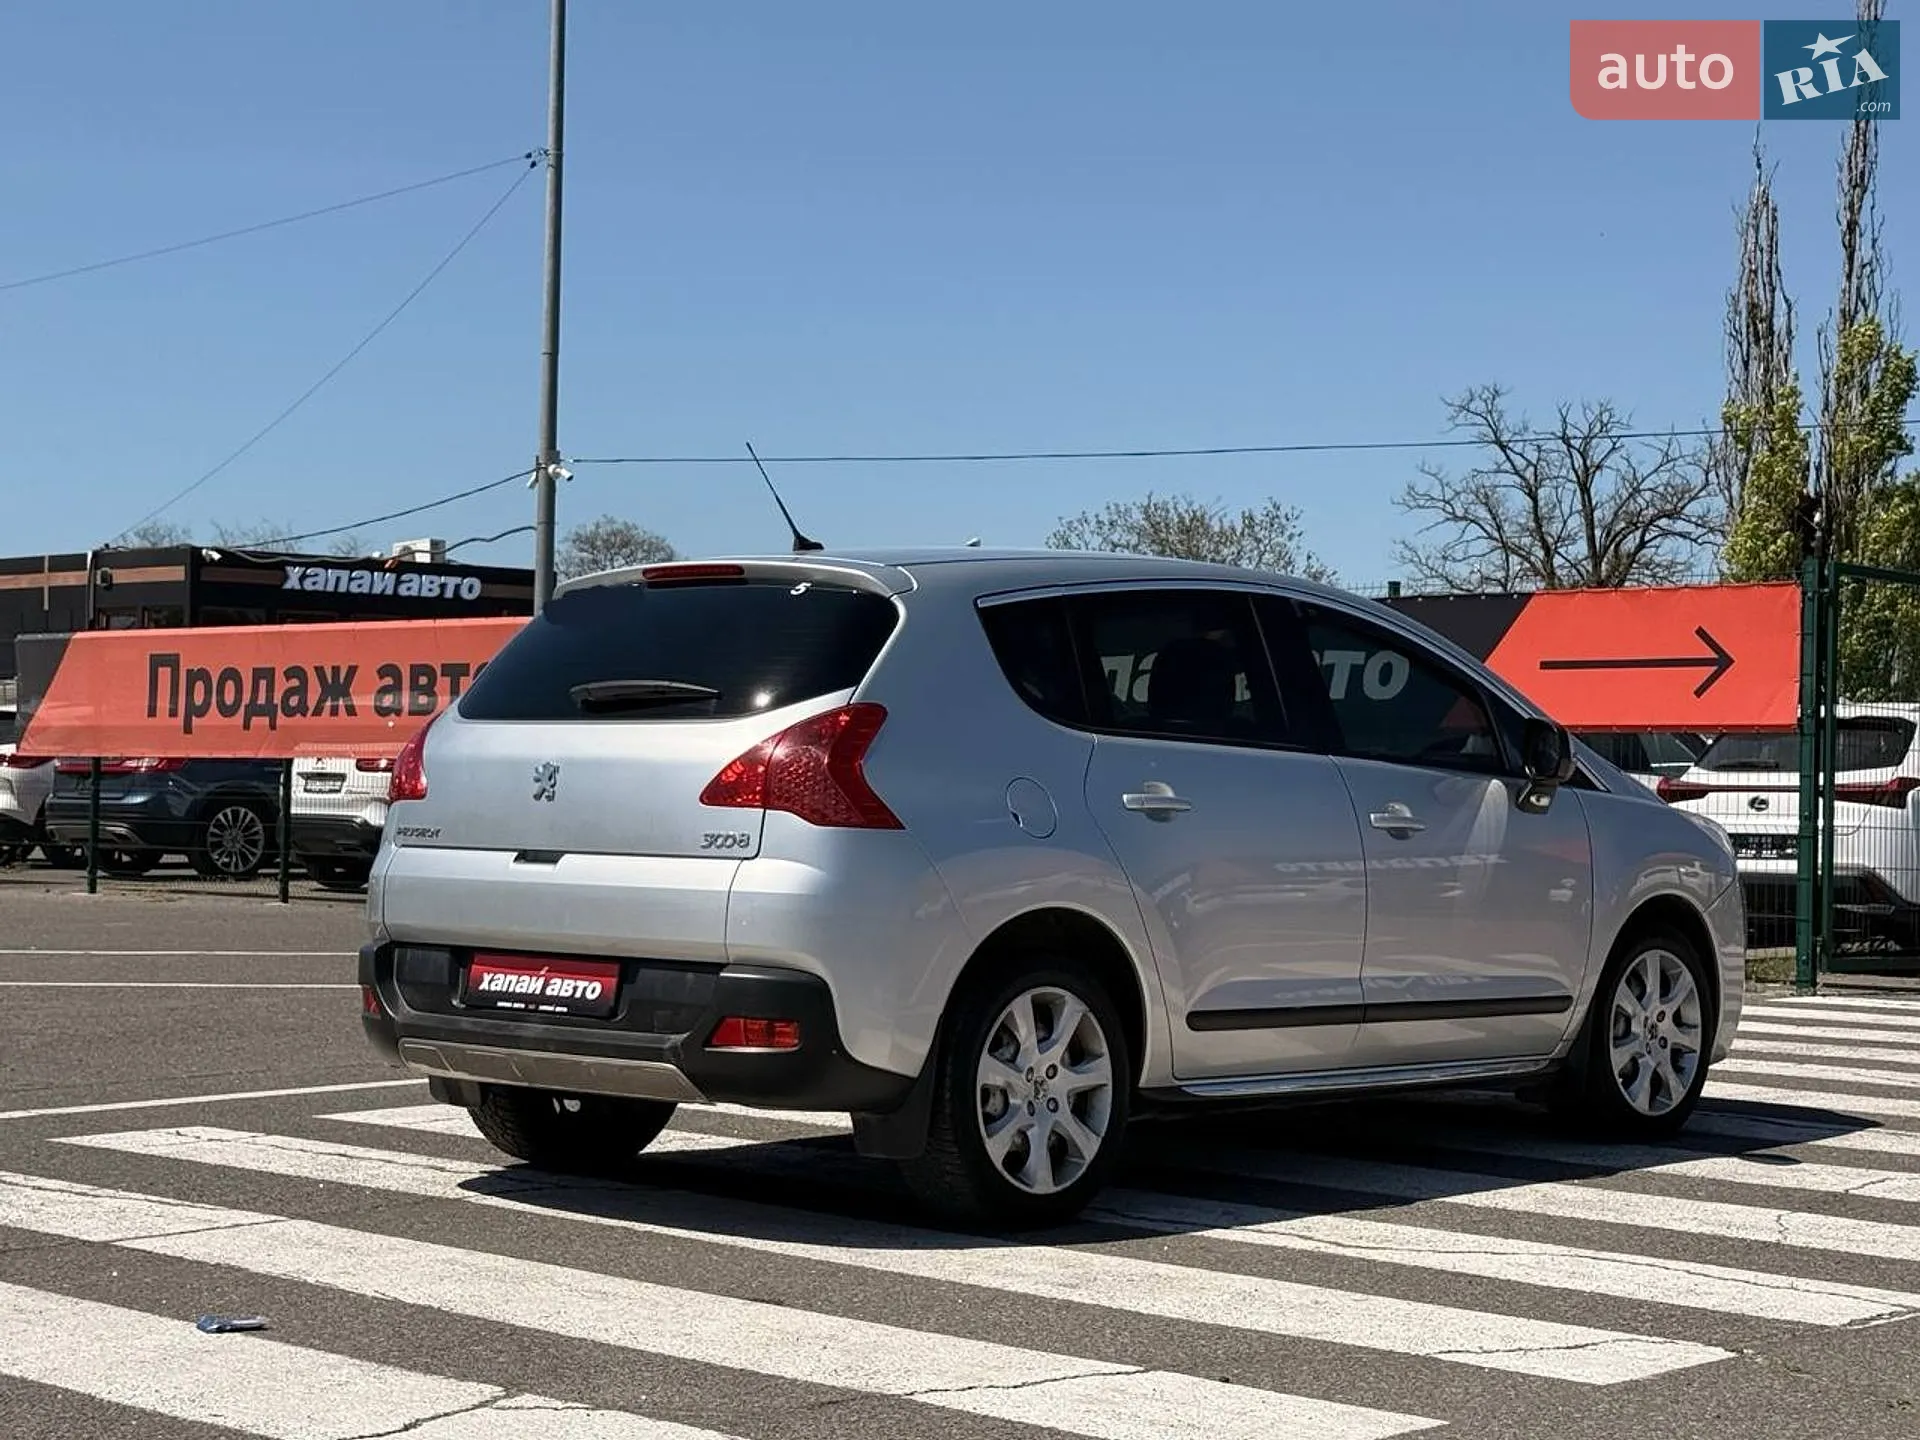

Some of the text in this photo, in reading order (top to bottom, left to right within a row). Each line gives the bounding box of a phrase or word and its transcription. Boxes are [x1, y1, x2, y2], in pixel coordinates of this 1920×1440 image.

[397, 572, 482, 601] авто
[147, 652, 489, 735] Продаж авт
[700, 832, 751, 850] 3008
[545, 976, 603, 1000] авто
